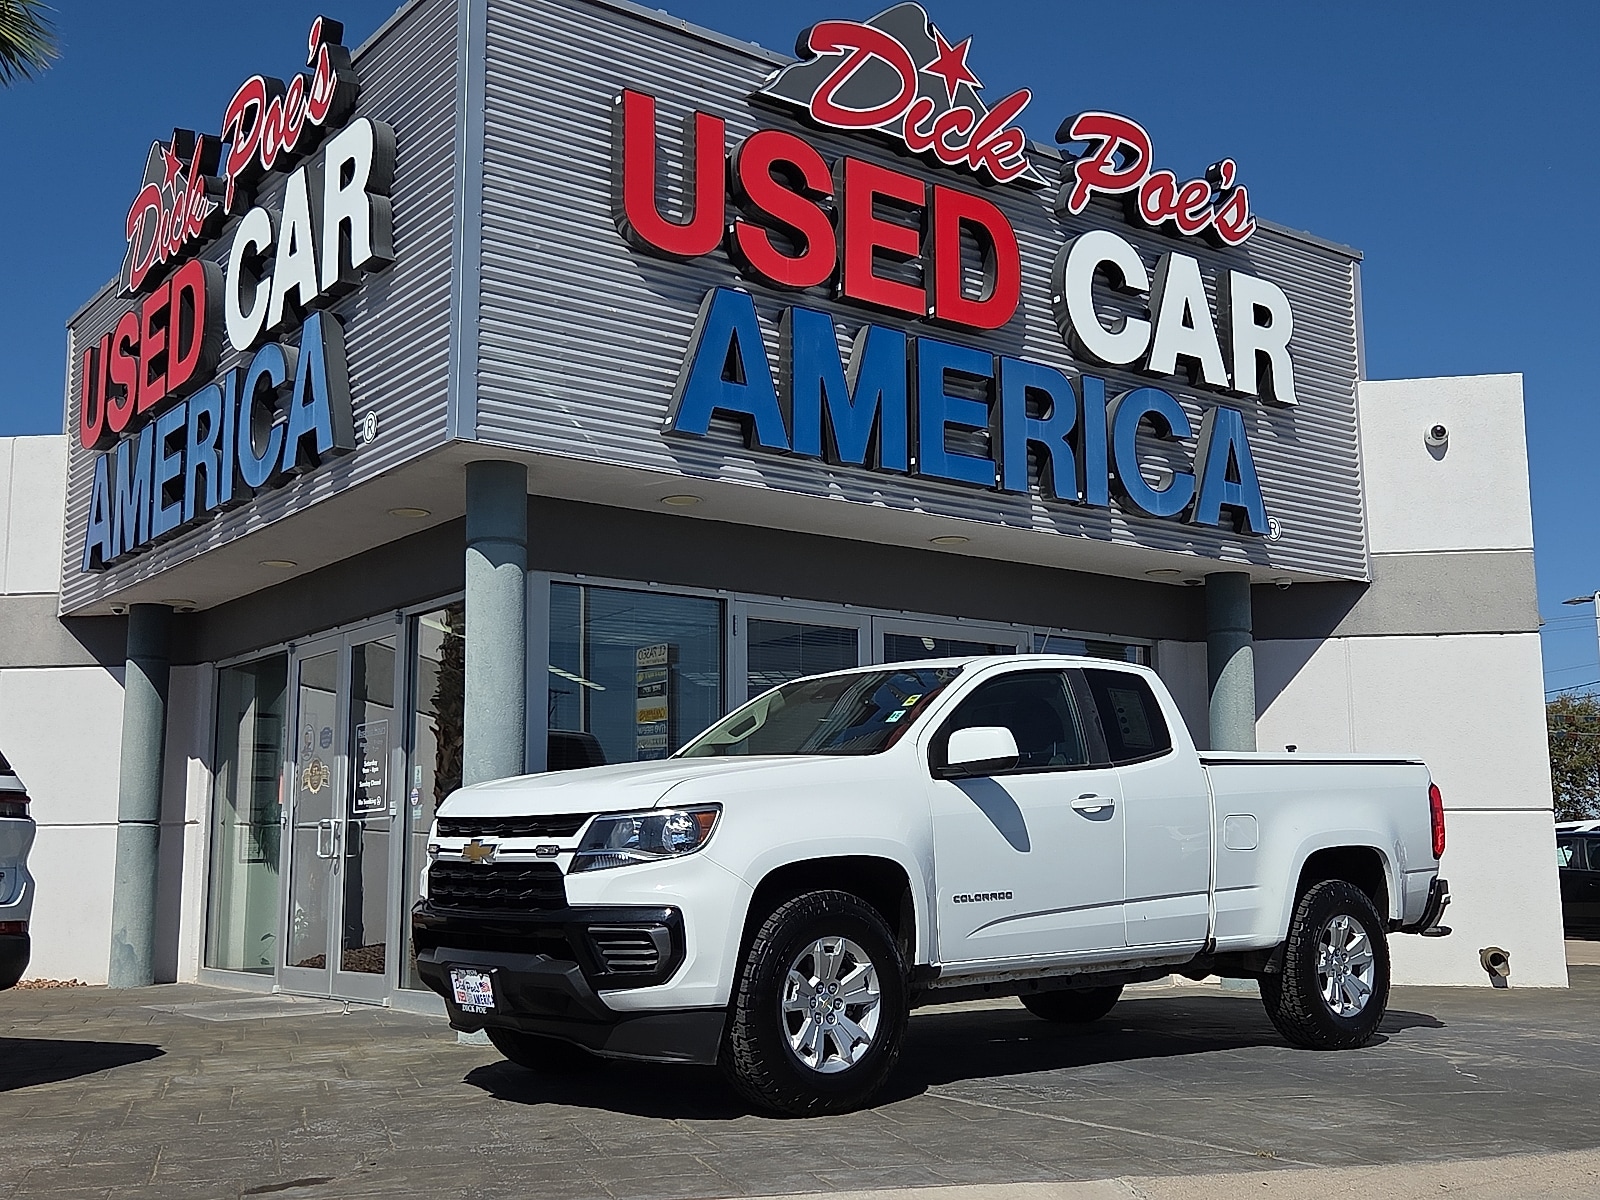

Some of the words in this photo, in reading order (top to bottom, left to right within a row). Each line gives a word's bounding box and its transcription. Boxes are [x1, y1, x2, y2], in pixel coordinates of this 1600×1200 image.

[127, 133, 207, 292] Dick
[221, 15, 338, 215] Poe's
[623, 87, 1021, 330] USED
[1065, 229, 1299, 406] CAR
[808, 20, 1034, 184] Dick
[1067, 111, 1257, 247] Poe's
[80, 259, 206, 449] USED
[225, 116, 374, 351] CAR
[82, 311, 334, 573] AMERICA
[672, 286, 1270, 536] AMERICA
[462, 1004, 475, 1013] DICK
[475, 1005, 487, 1014] POE
[952, 891, 1013, 904] COLORADO
